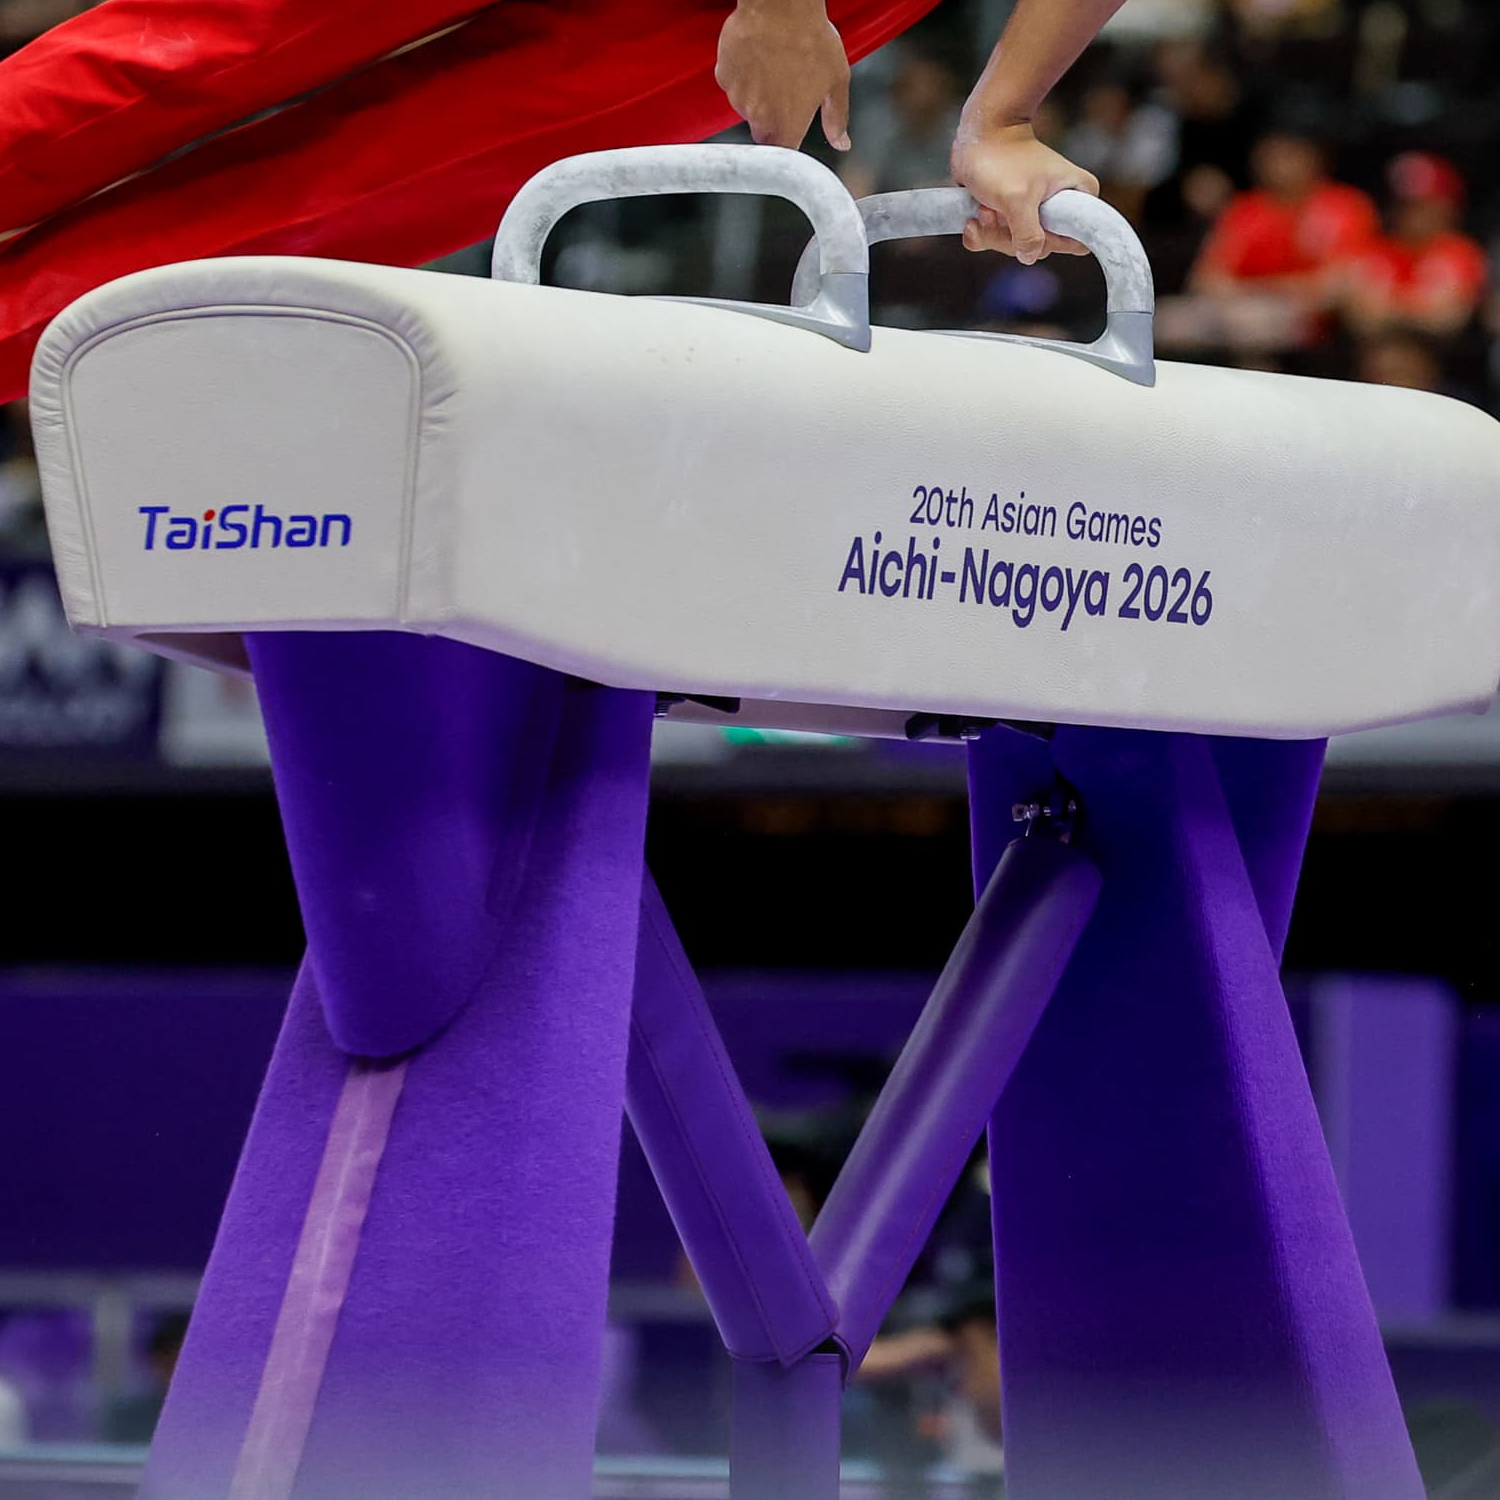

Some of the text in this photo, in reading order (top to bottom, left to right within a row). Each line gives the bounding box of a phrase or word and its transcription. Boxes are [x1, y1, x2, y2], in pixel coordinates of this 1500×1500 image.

[138, 504, 352, 550] TaiShan
[909, 485, 1162, 548] 20th Asian Games
[837, 531, 1213, 631] Aichi-Nagoya 2026
